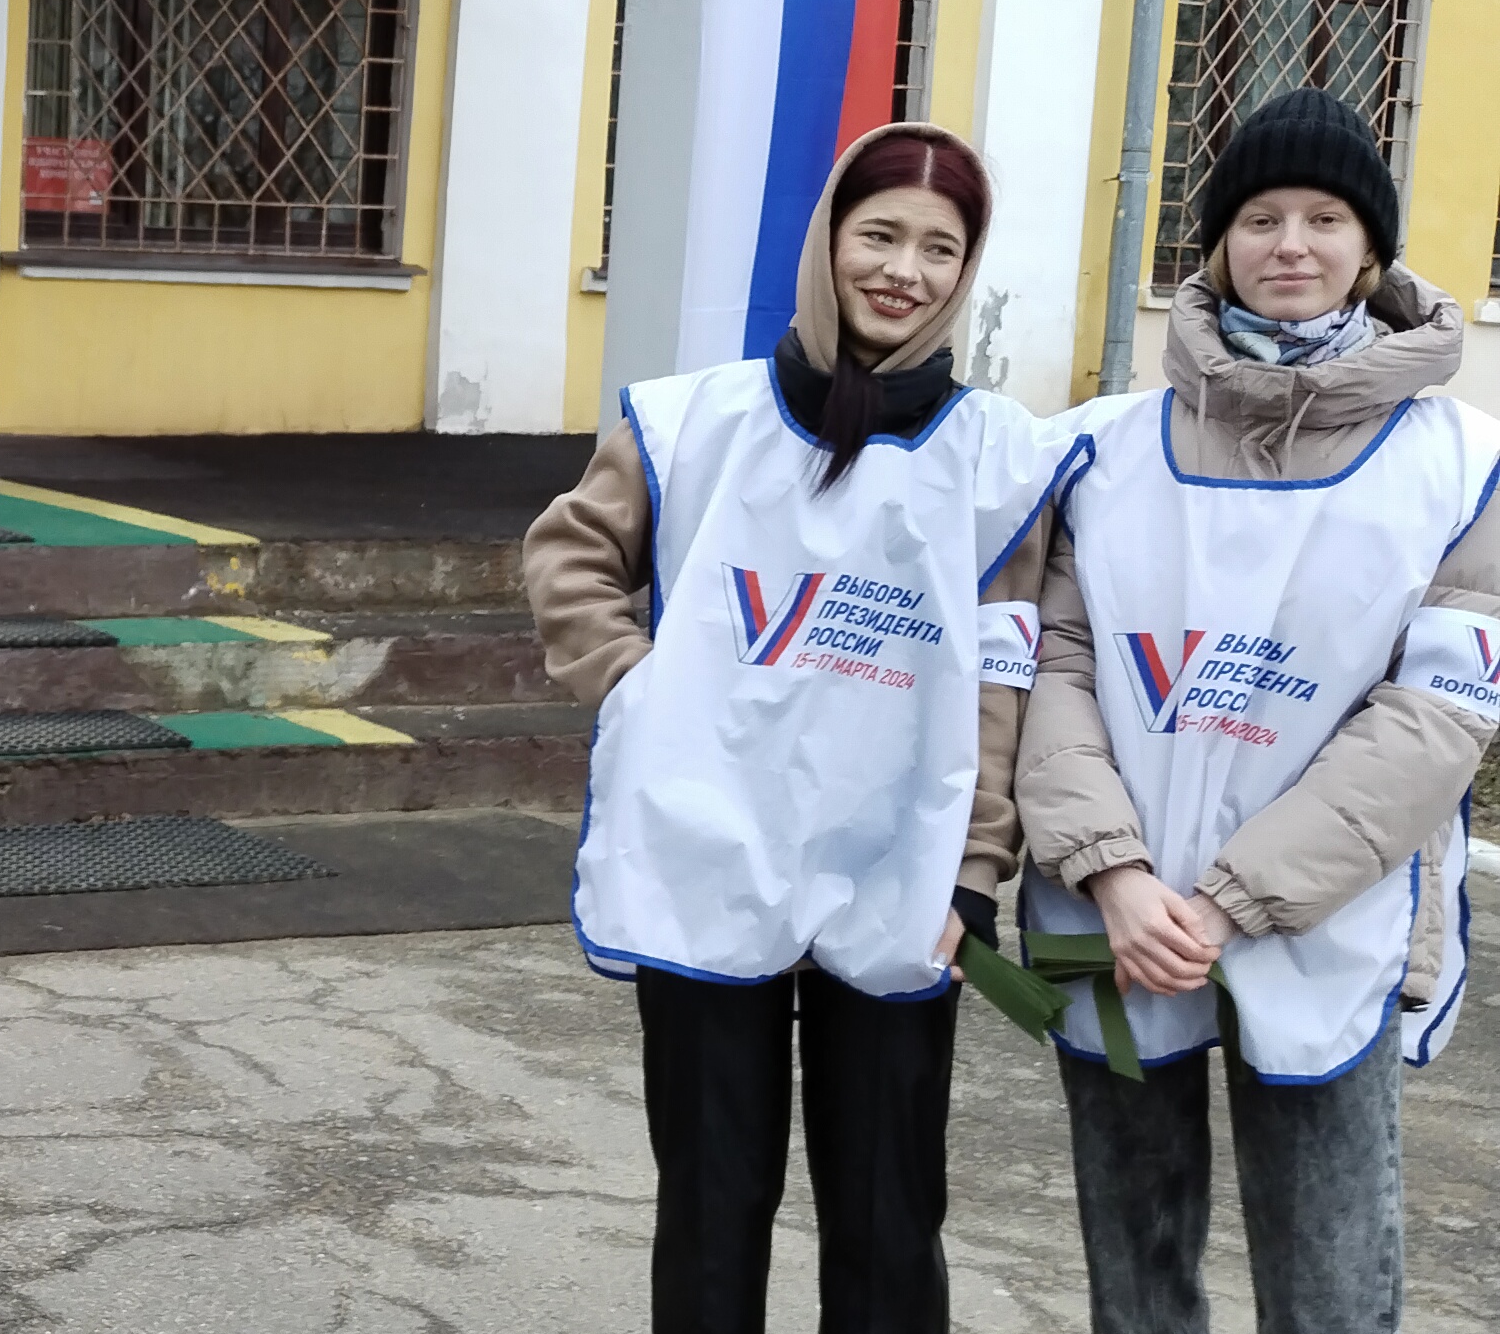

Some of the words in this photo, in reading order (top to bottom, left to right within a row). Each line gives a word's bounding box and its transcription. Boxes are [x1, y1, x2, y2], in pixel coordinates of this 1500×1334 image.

[831, 574, 925, 610] ВЫБОРЫ
[817, 600, 944, 645] ПРЕЗИДЕНТА
[803, 627, 884, 658] РОССИИ
[830, 657, 879, 681] МАРТА
[878, 668, 916, 690] 2024
[982, 658, 1035, 677] ВОЛО
[1429, 674, 1500, 707] ВОЛОН
